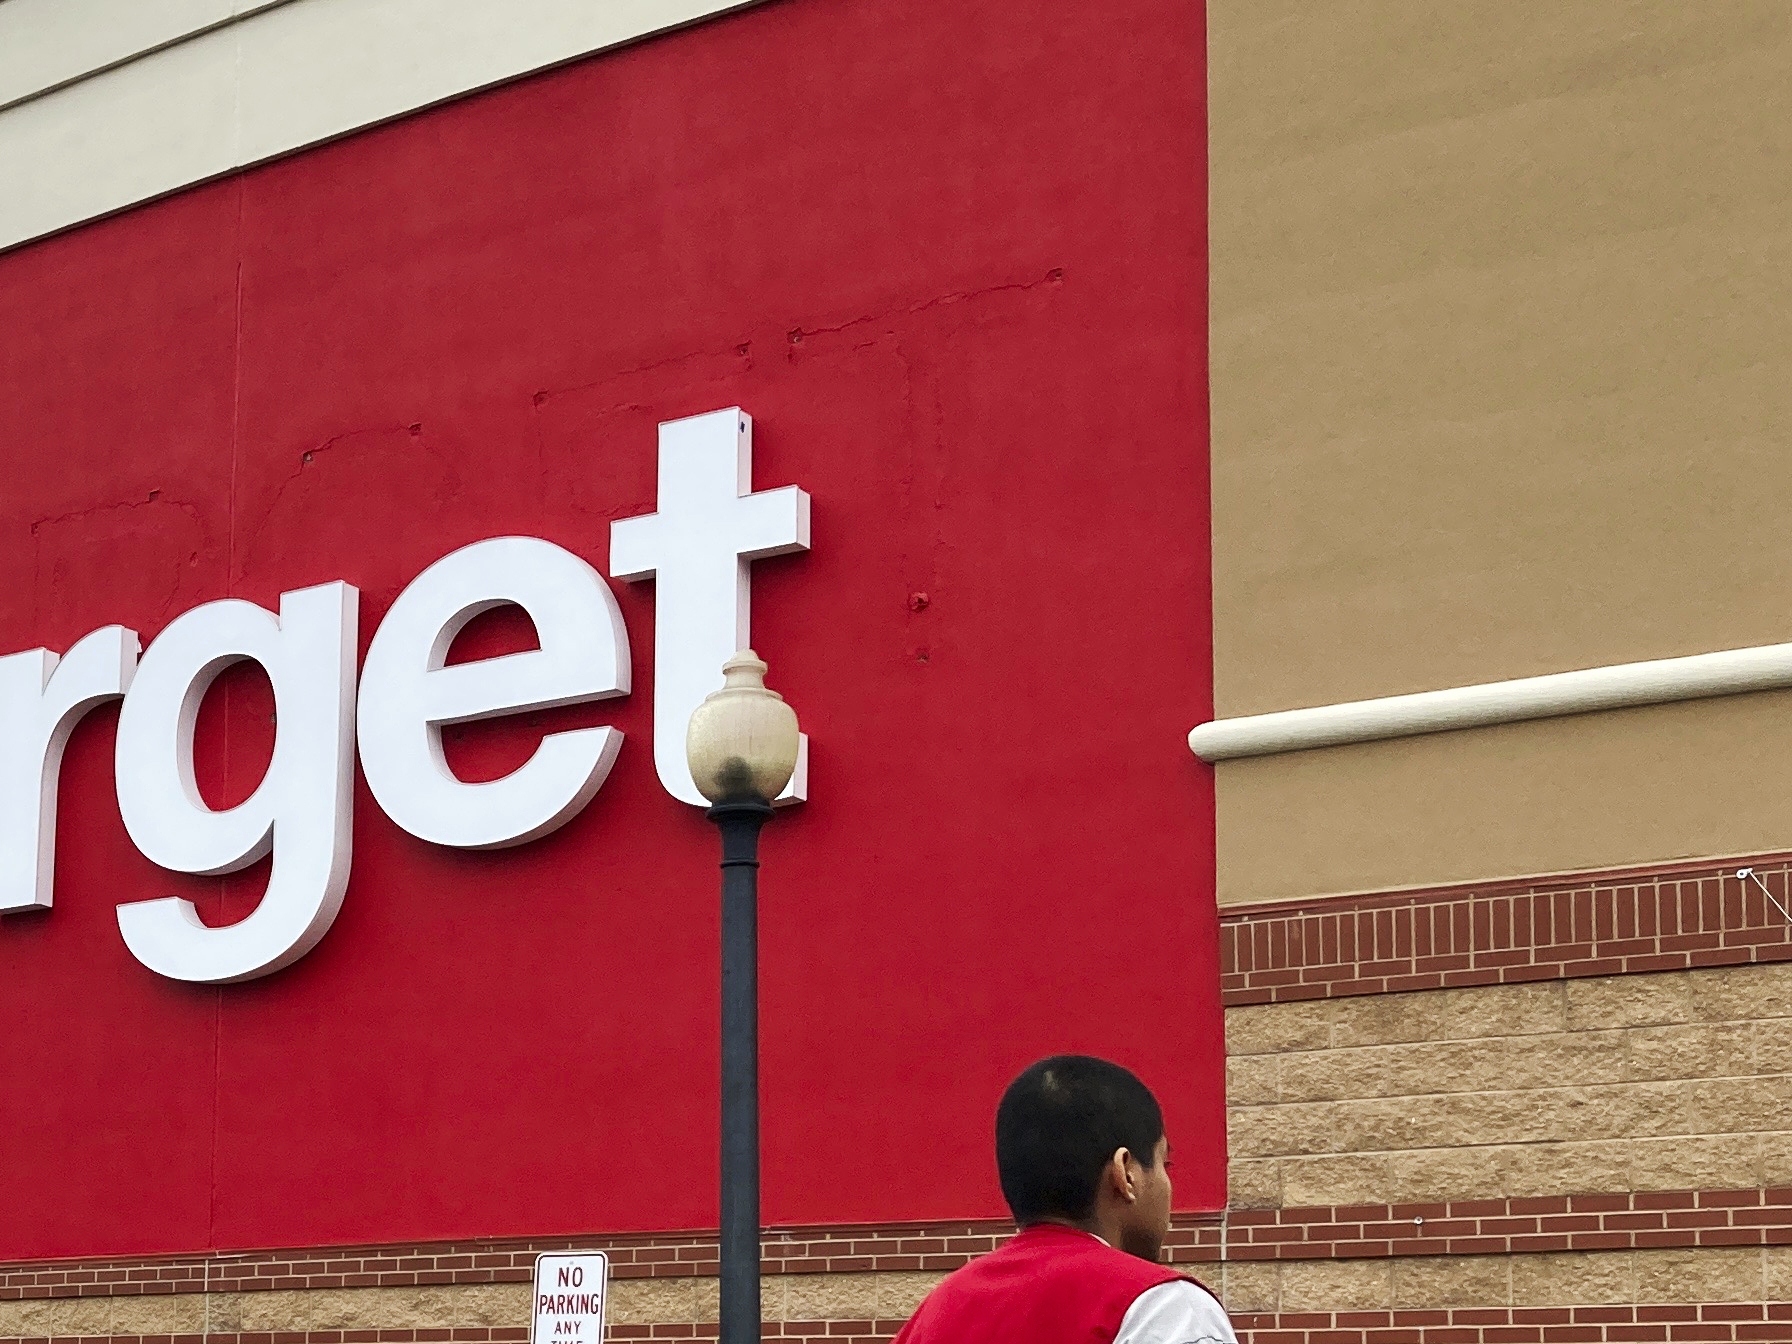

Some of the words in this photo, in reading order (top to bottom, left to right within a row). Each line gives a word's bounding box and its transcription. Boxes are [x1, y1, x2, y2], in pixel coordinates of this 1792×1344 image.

[558, 1267, 583, 1287] NO
[539, 1294, 599, 1314] PARKING
[554, 1321, 581, 1334] ANY
